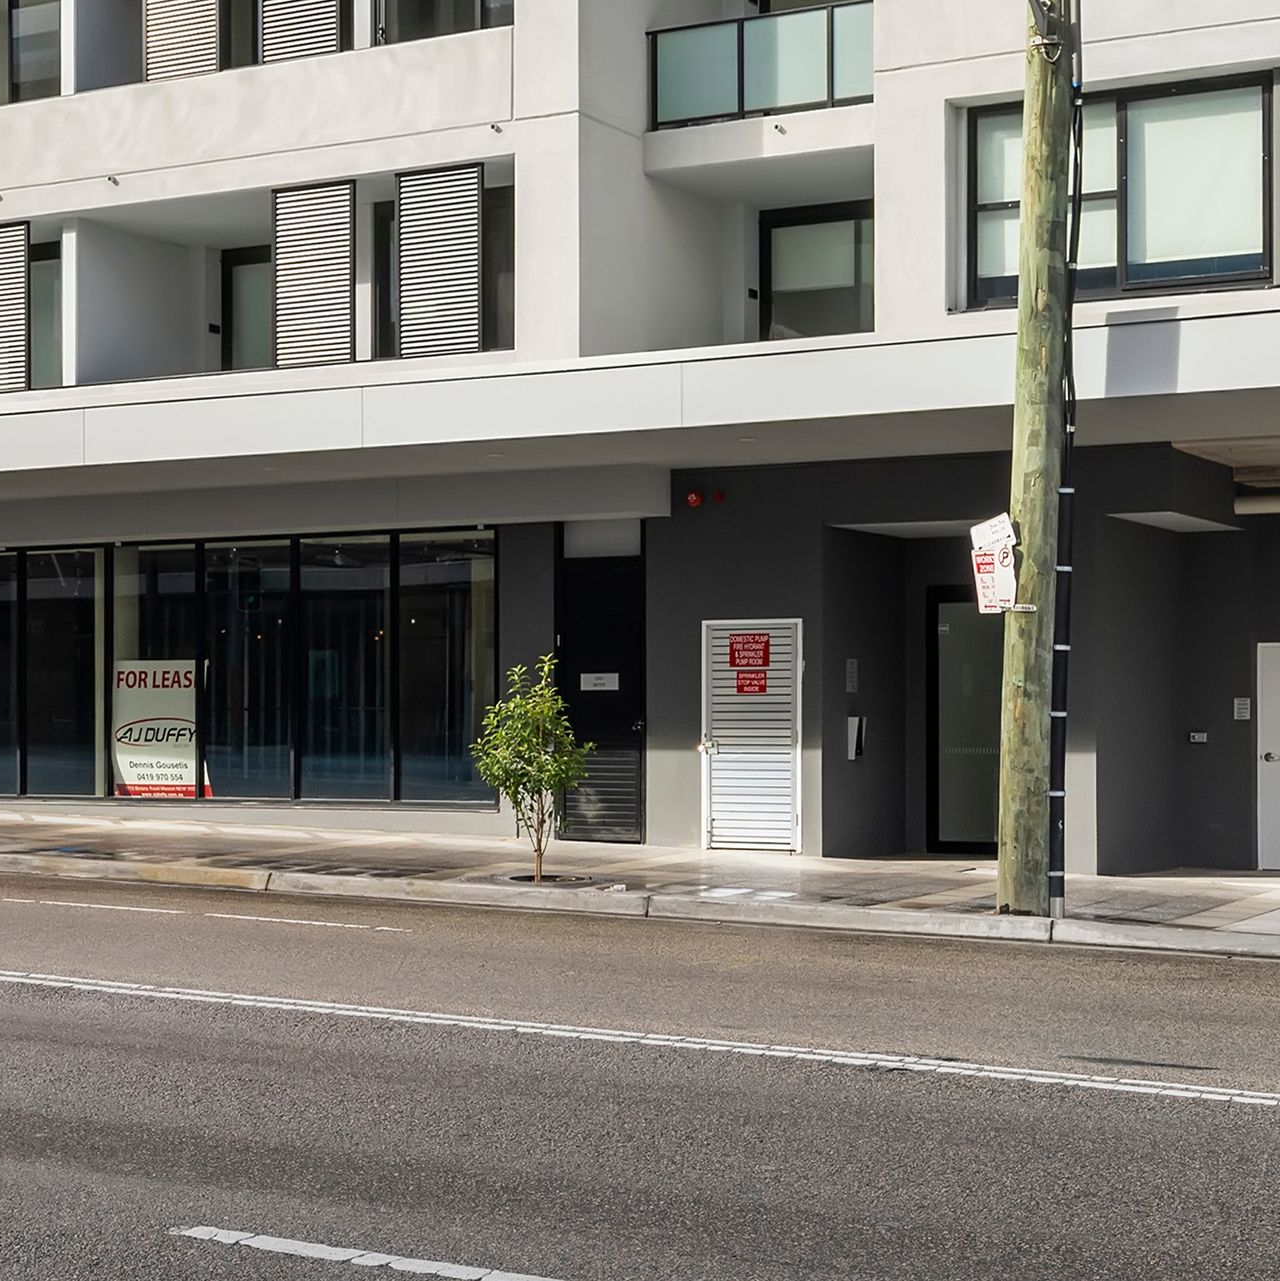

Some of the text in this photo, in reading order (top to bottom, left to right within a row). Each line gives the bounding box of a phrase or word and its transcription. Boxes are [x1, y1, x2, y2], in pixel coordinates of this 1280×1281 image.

[730, 635, 769, 643] DOMESTIC PUMP
[739, 650, 764, 658] SPRINKLER
[116, 670, 197, 689] FOR LEAS
[129, 761, 188, 769] Dennis Gousetis
[137, 773, 183, 781] 0419 970 554
